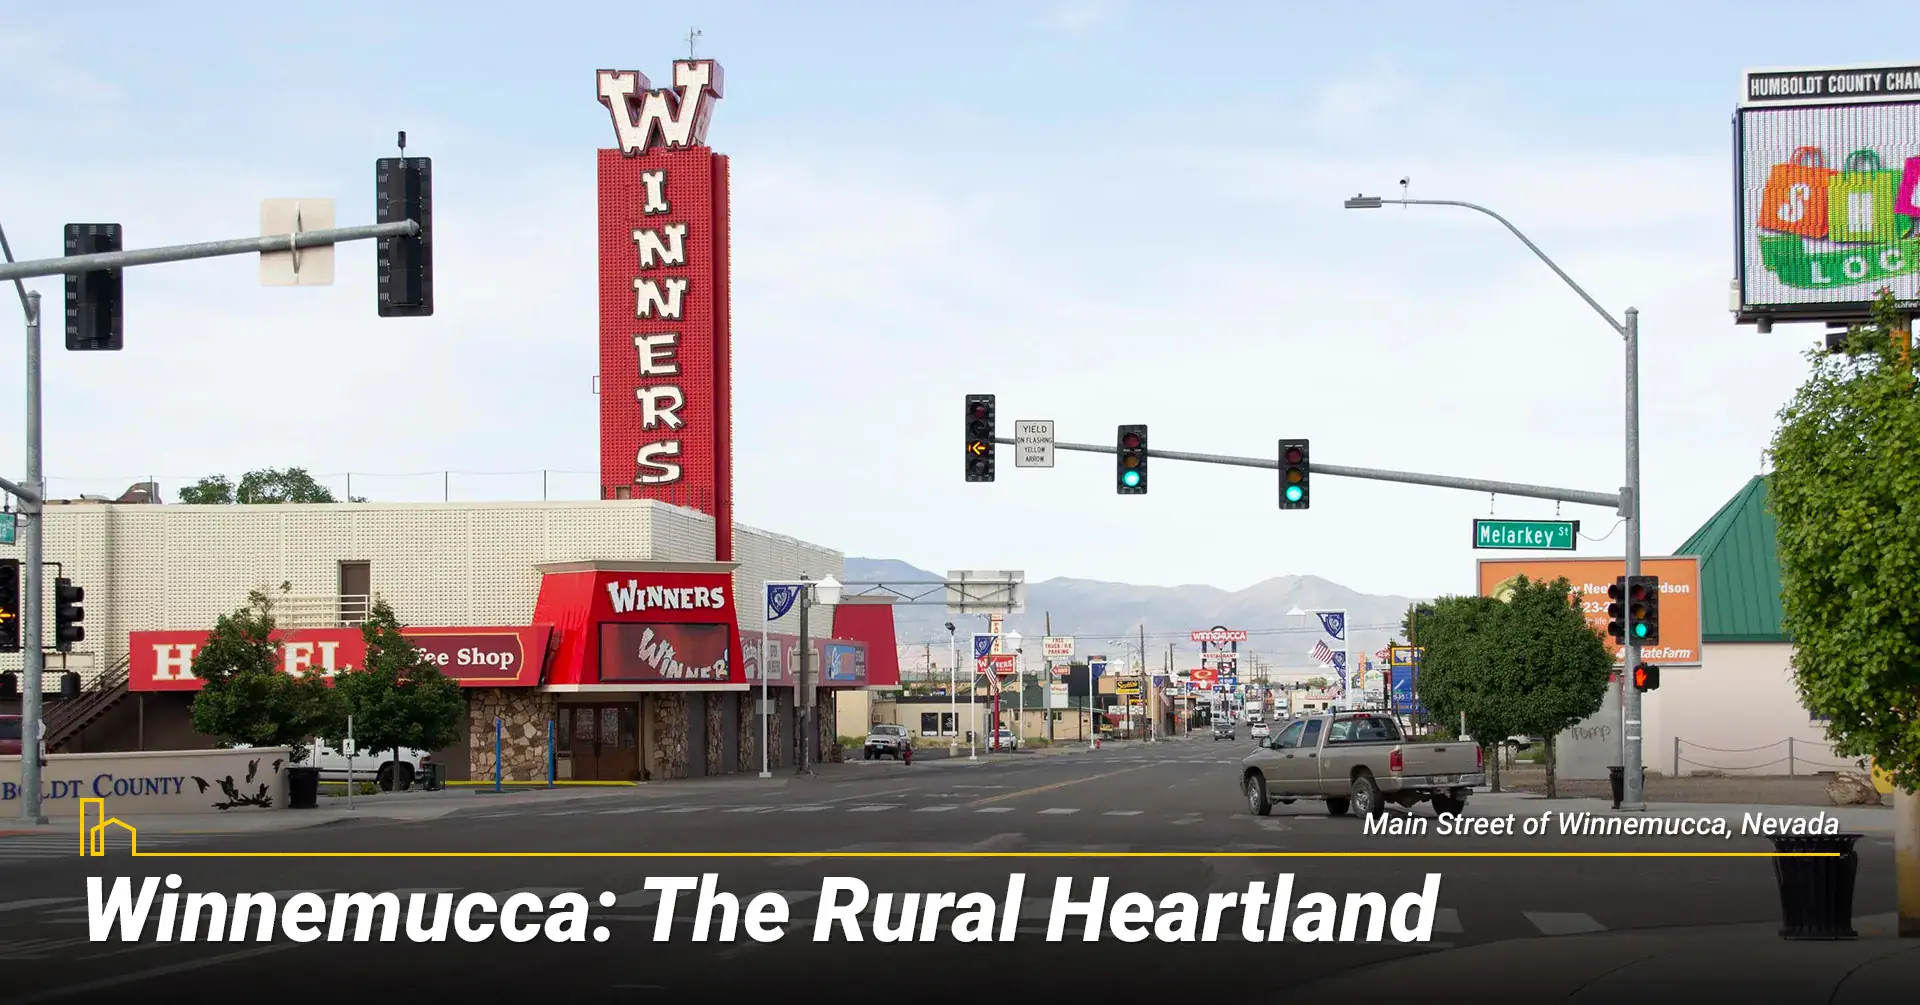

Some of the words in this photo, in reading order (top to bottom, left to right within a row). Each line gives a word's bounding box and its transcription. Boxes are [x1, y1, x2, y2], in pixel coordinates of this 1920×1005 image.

[1750, 76, 1823, 96] HUMBOLDT
[1828, 74, 1881, 93] COUNTY
[596, 59, 724, 486] WINNERS
[1023, 425, 1047, 433] YIELD
[1480, 525, 1554, 547] Melarkey
[1558, 526, 1569, 536] St
[606, 579, 726, 613] WINNERS
[457, 647, 515, 671] Shop
[92, 773, 186, 798] COUNTY
